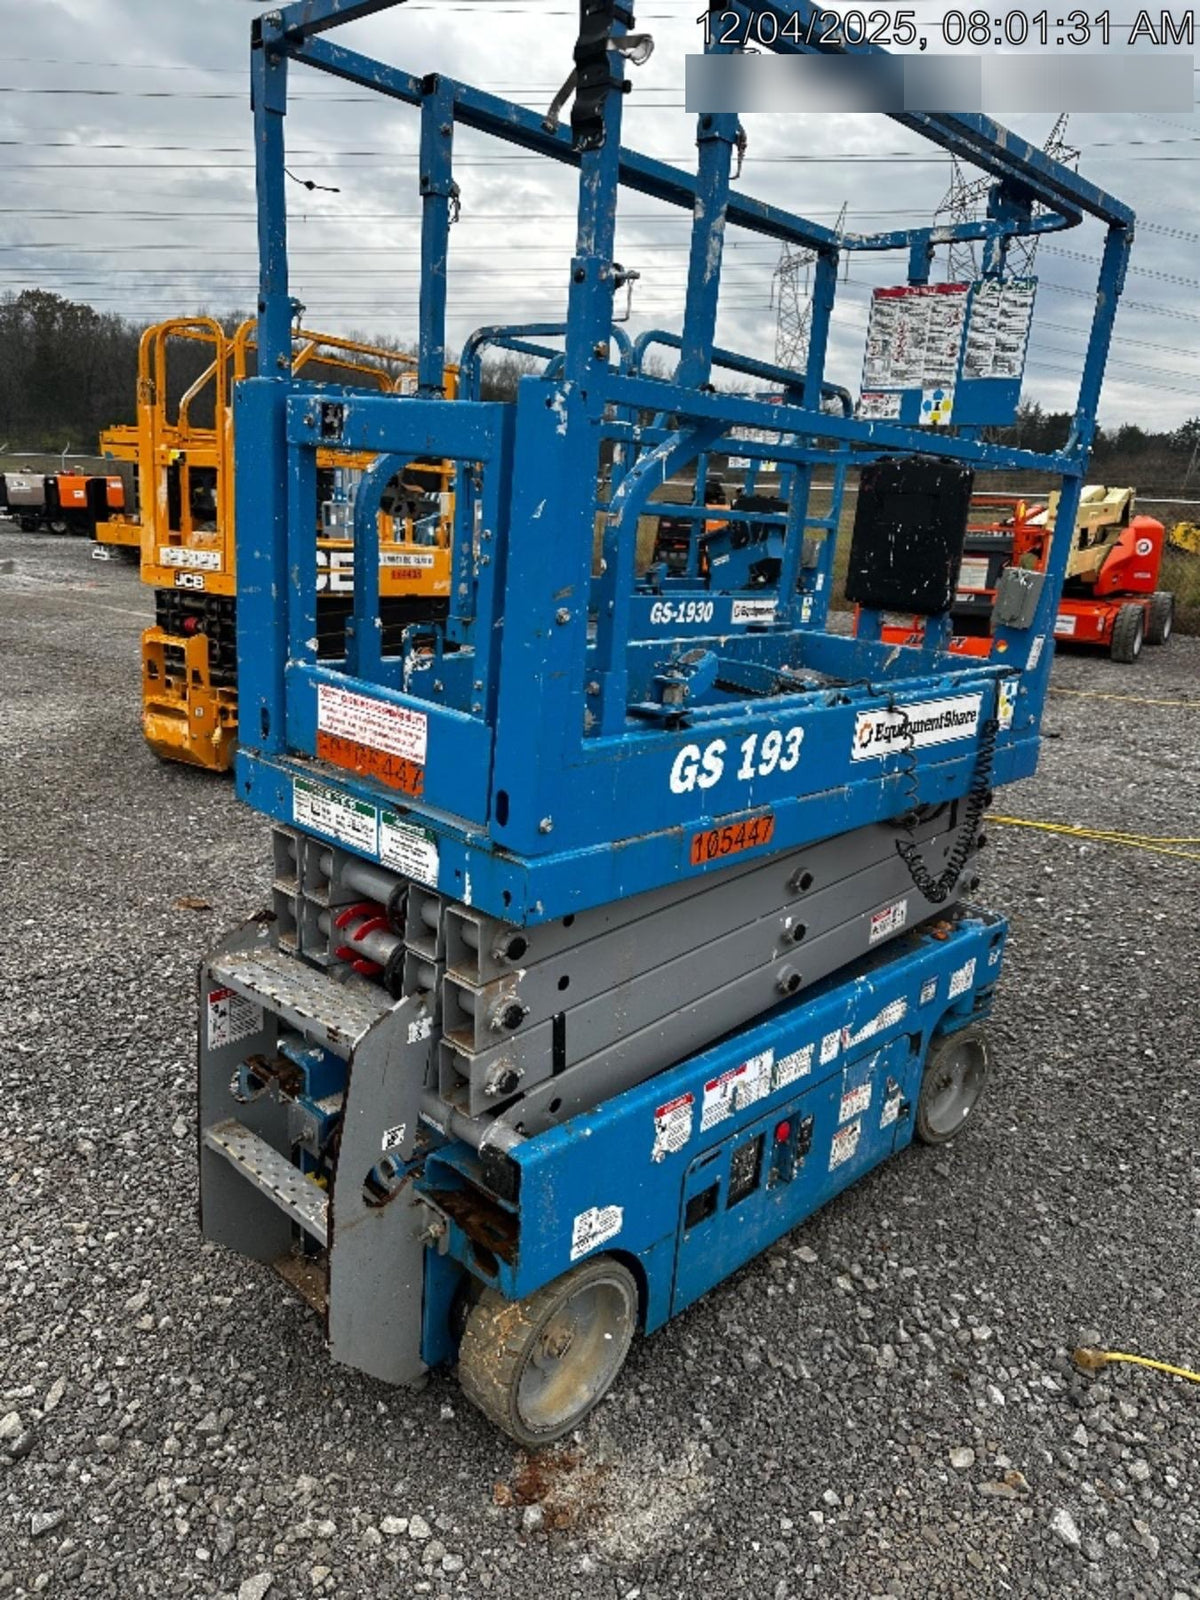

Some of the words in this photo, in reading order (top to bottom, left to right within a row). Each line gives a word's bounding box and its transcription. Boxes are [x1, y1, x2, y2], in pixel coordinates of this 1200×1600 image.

[175, 573, 204, 589] JCB
[650, 601, 714, 624] GS-1930
[669, 738, 727, 794] GS
[737, 726, 804, 781] 193
[694, 815, 774, 863] 105447
